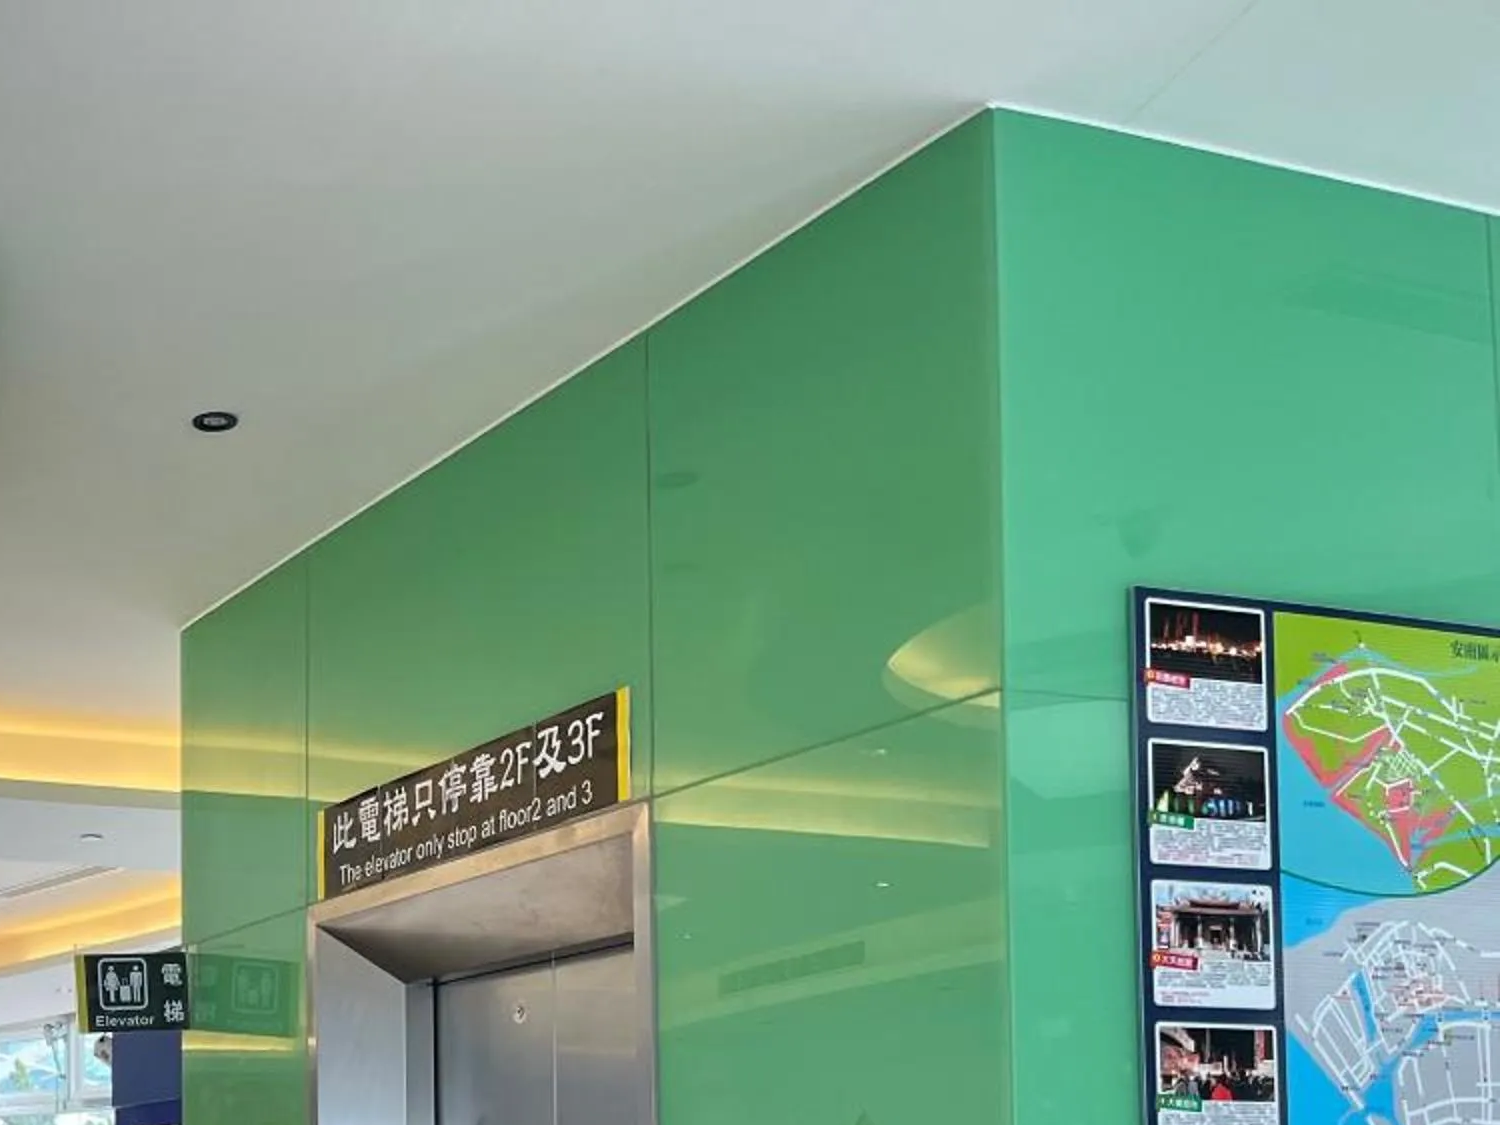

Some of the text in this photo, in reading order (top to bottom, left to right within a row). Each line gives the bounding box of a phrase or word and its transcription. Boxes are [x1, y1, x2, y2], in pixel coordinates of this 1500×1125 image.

[331, 711, 605, 854] 此電梯只停靠2F及3F
[339, 780, 593, 886] The elevator only stop at floor2 and 3
[94, 1015, 155, 1028] Elevator
[160, 963, 184, 1023] 電梯
